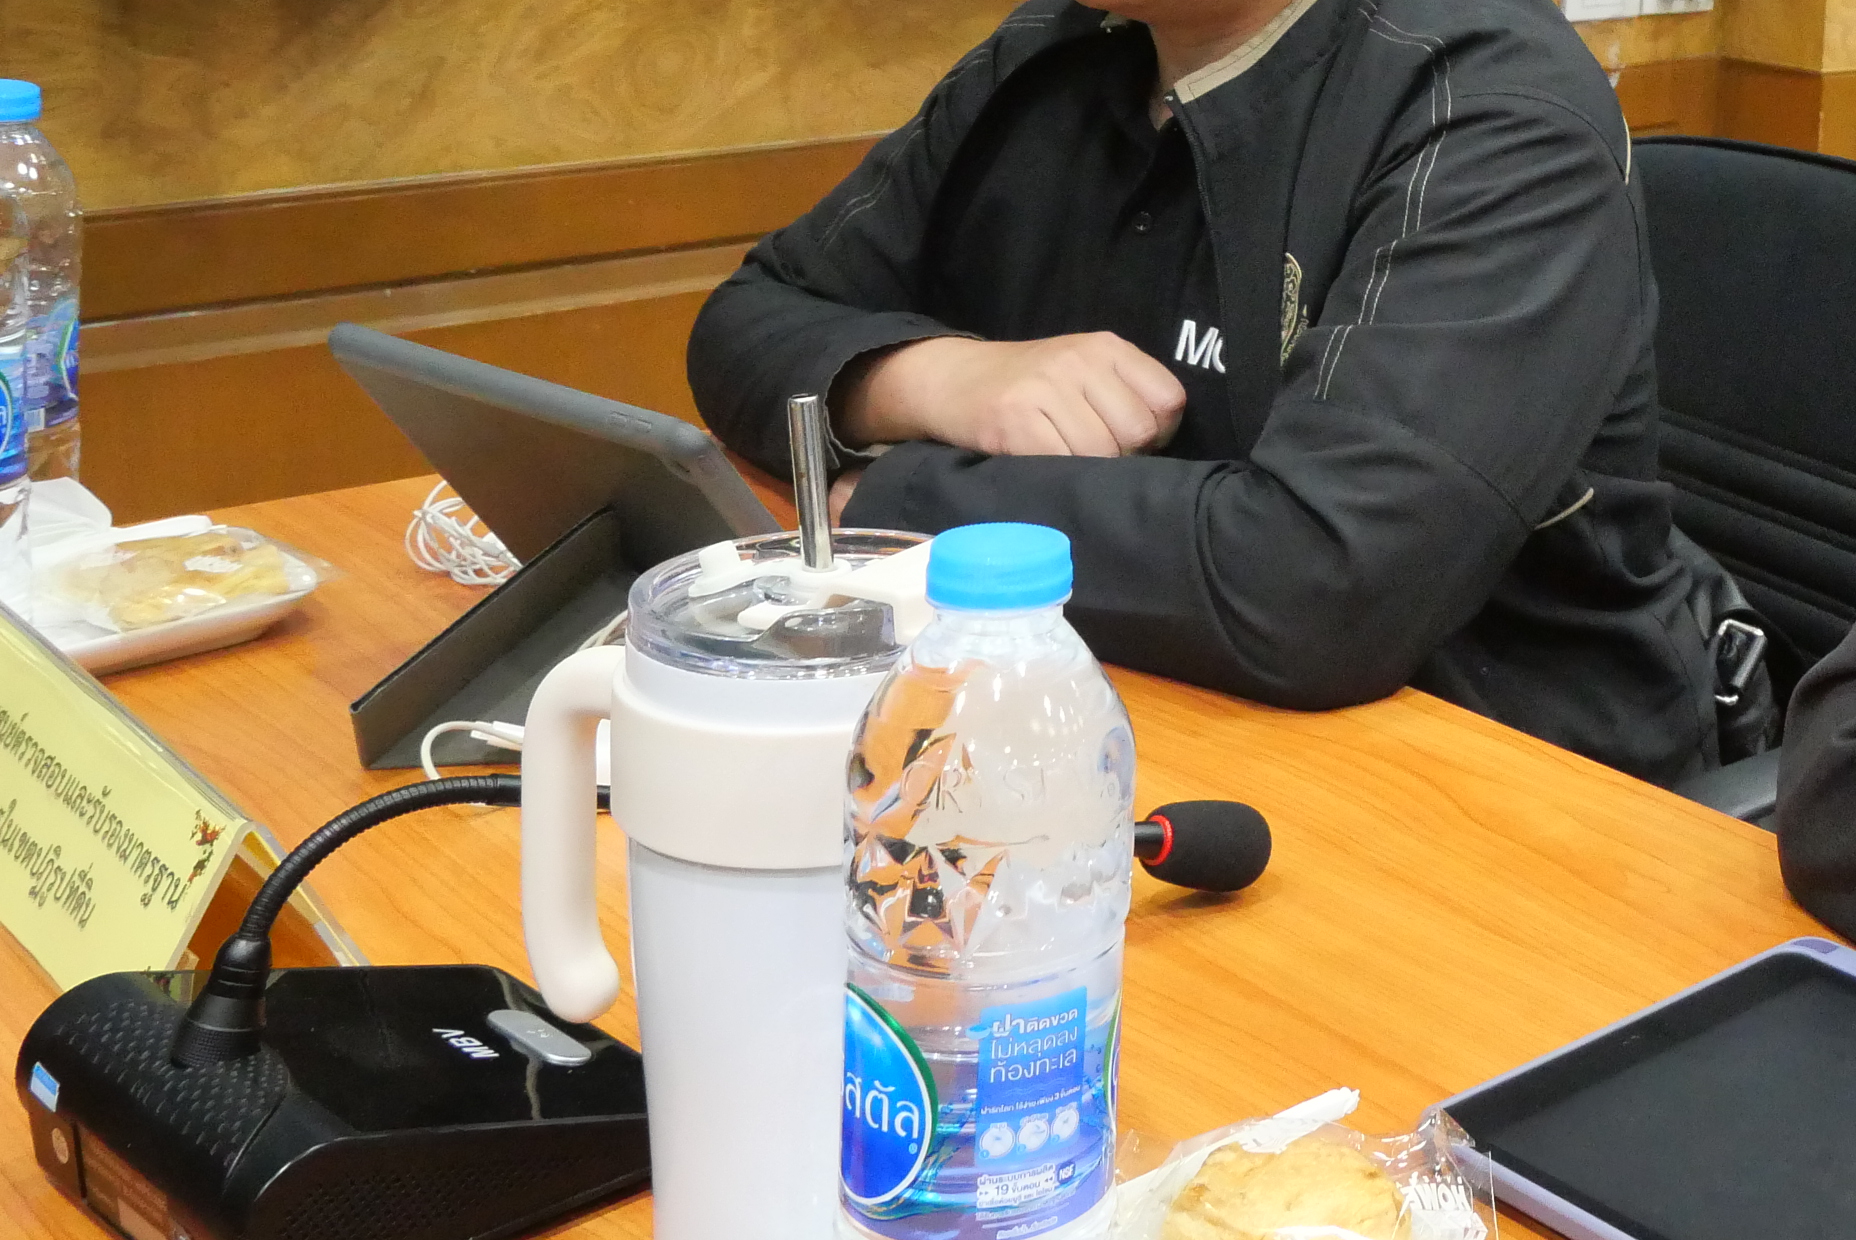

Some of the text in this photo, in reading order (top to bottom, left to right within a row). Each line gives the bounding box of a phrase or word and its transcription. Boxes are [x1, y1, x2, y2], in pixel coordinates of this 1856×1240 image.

[992, 1008, 1078, 1037] ฝาติดขวด
[432, 1028, 500, 1059] MBV
[991, 1026, 1078, 1059] ไม่หลุดลง
[990, 1048, 1077, 1083] ท้องทะเล
[995, 1183, 1009, 1196] 19
